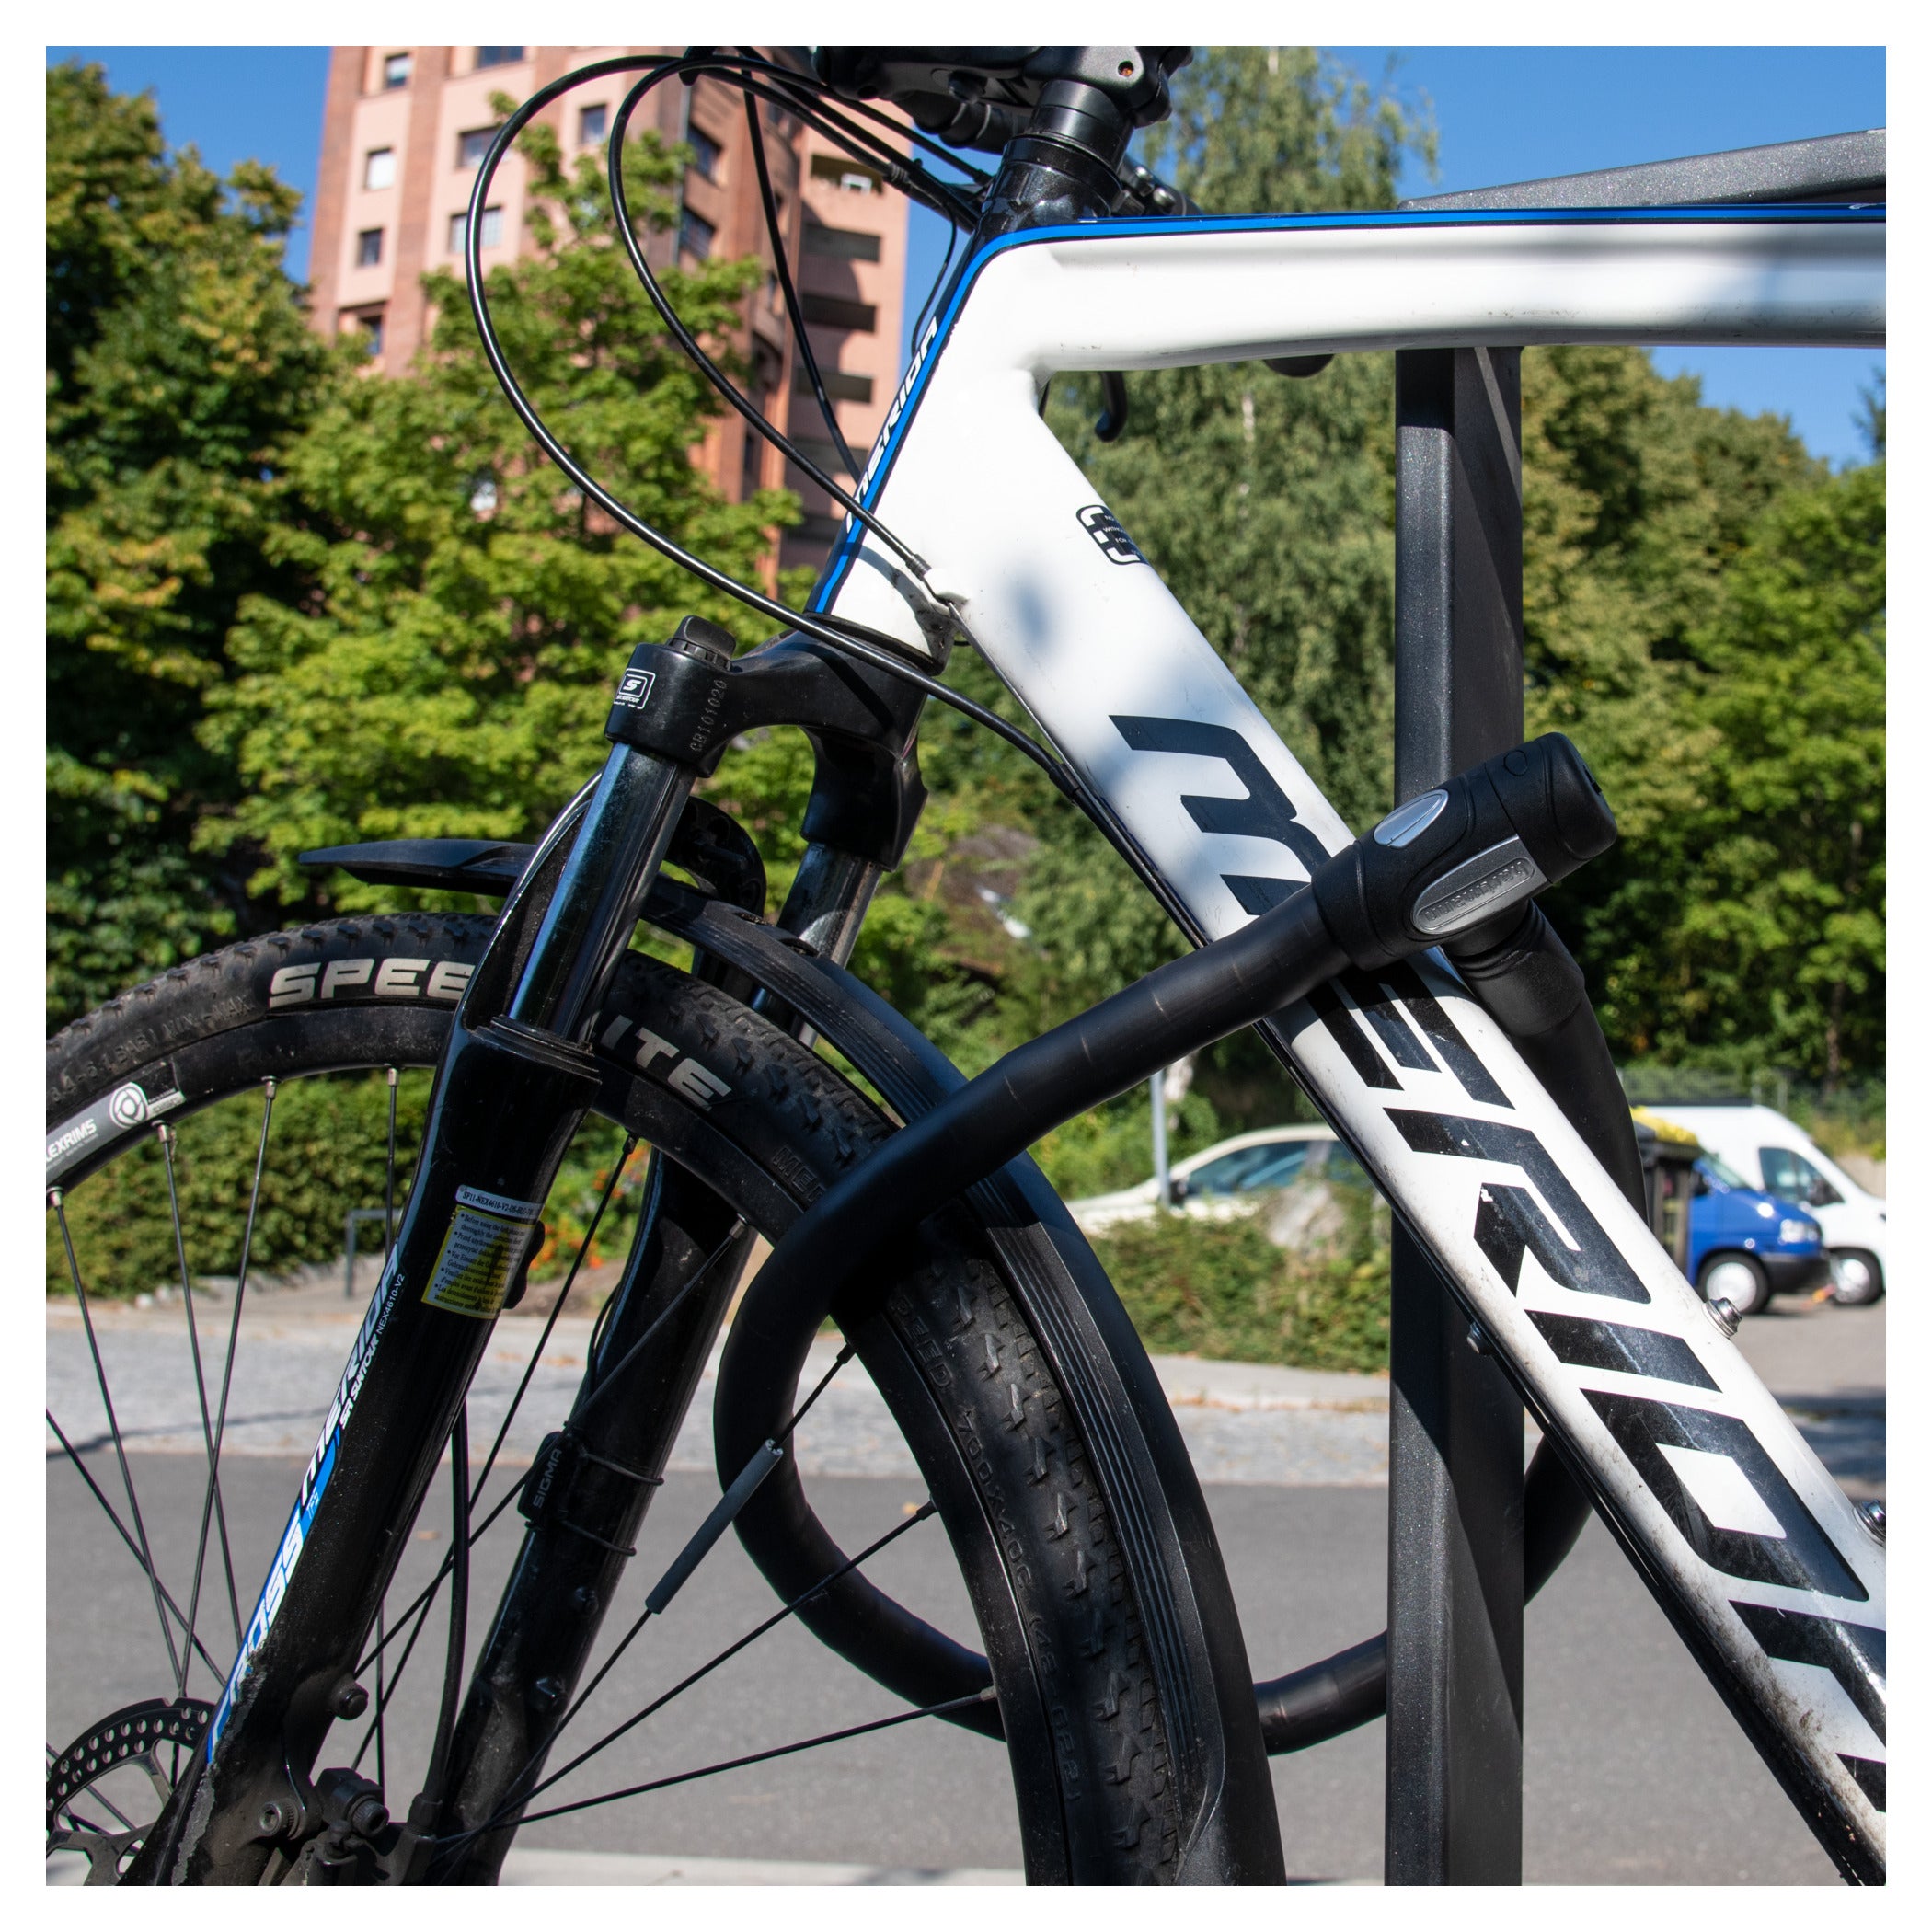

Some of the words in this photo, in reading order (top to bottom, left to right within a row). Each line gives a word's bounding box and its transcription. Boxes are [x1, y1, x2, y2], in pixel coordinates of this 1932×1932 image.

[269, 958, 476, 1008] SPEE
[600, 1014, 732, 1111] ITE
[46, 1119, 98, 1162] LEXRIMS
[350, 1333, 380, 1402] SUNTOUR
[376, 1273, 405, 1335] NEX4610-V2
[533, 1448, 562, 1509] SIGMA
